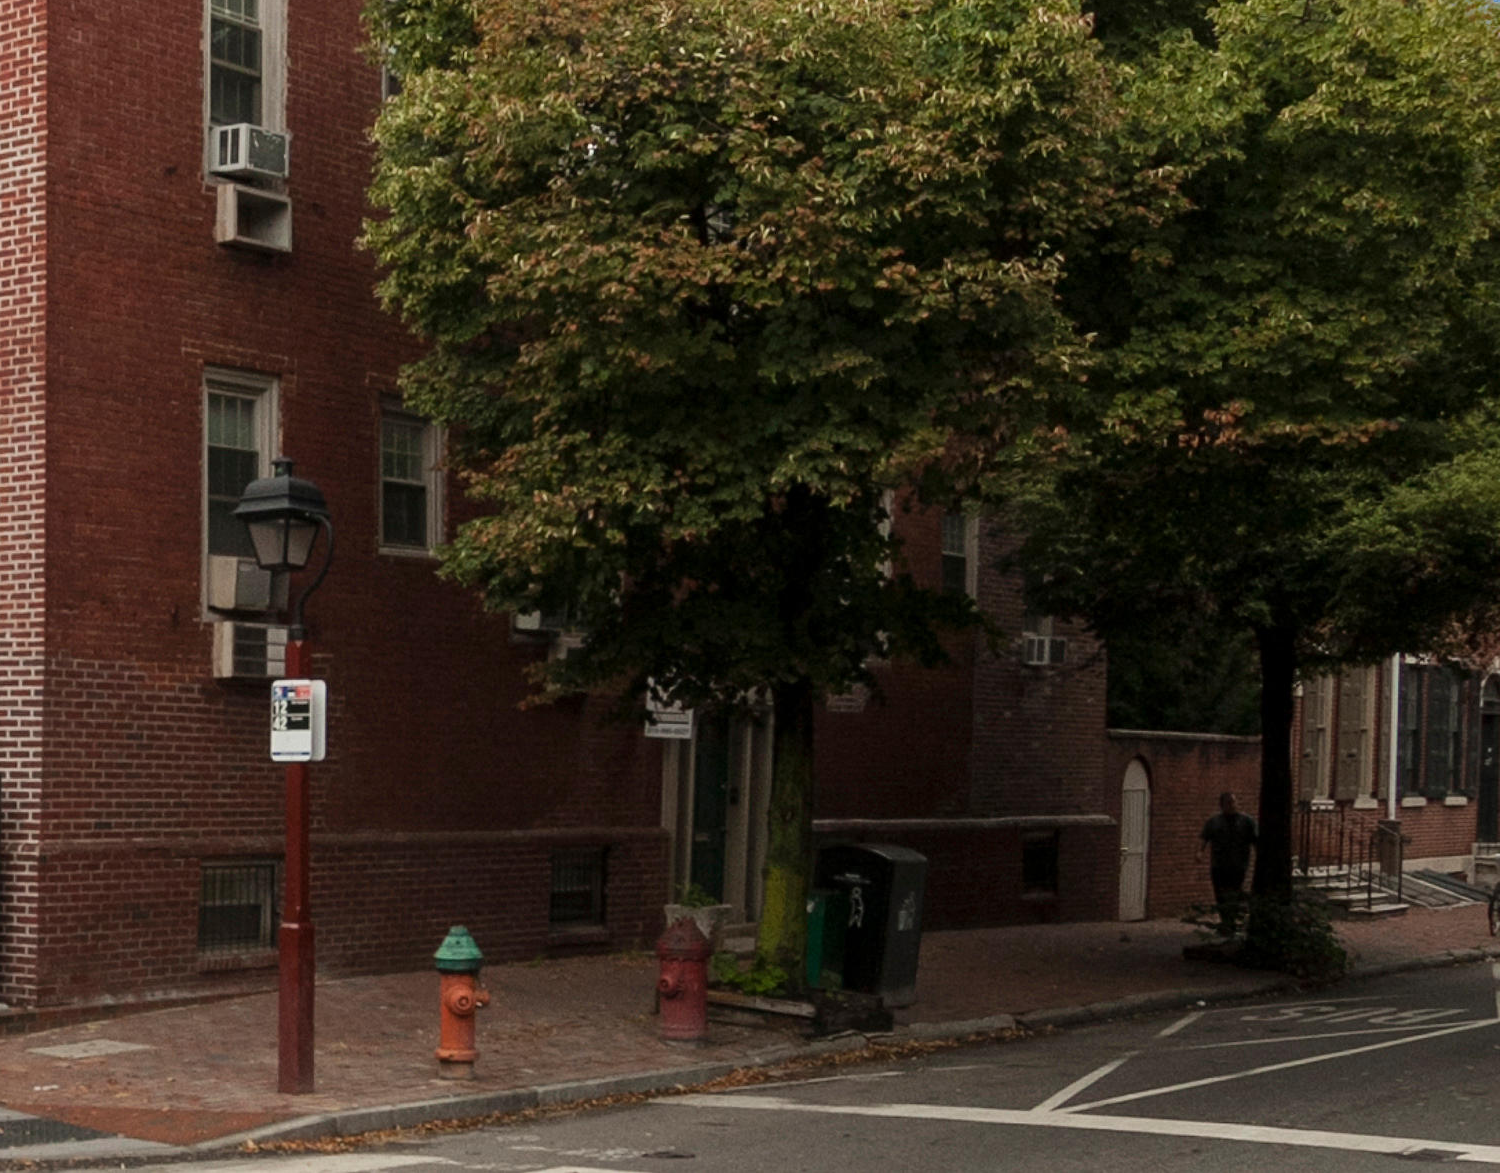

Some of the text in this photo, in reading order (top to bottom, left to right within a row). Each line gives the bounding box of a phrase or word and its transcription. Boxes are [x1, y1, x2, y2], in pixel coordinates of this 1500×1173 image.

[274, 700, 288, 714] 12
[273, 716, 288, 731] 42
[1240, 1006, 1468, 1025] BUS
